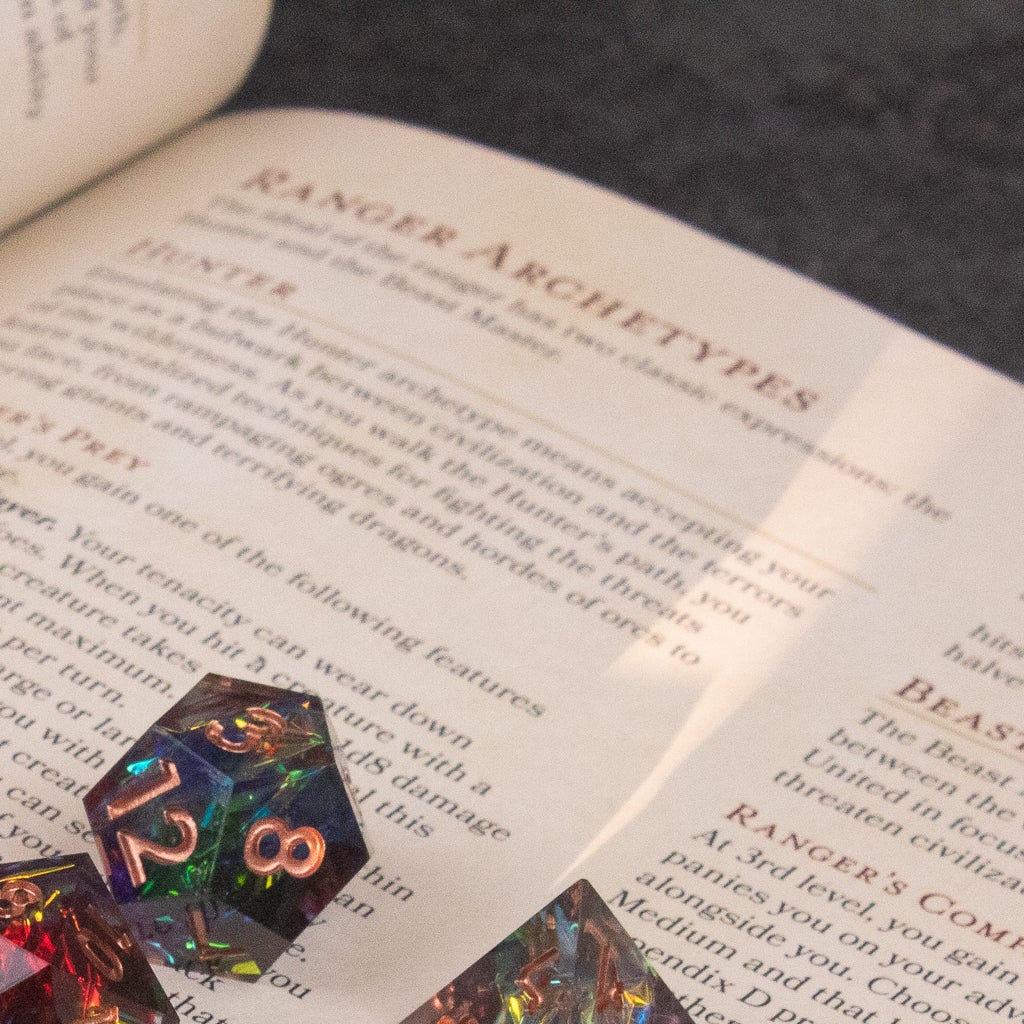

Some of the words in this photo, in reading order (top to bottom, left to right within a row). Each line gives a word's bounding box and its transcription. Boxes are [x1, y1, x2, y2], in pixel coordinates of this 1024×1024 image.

[461, 242, 822, 414] ARCHETYPES
[60, 426, 151, 473] PREY
[107, 759, 198, 887] 12
[244, 817, 326, 879] 8
[725, 803, 908, 897] RANGER'S
[691, 828, 732, 854] At
[735, 849, 798, 881] 3rd
[877, 917, 944, 951] you
[943, 948, 1020, 986] gain
